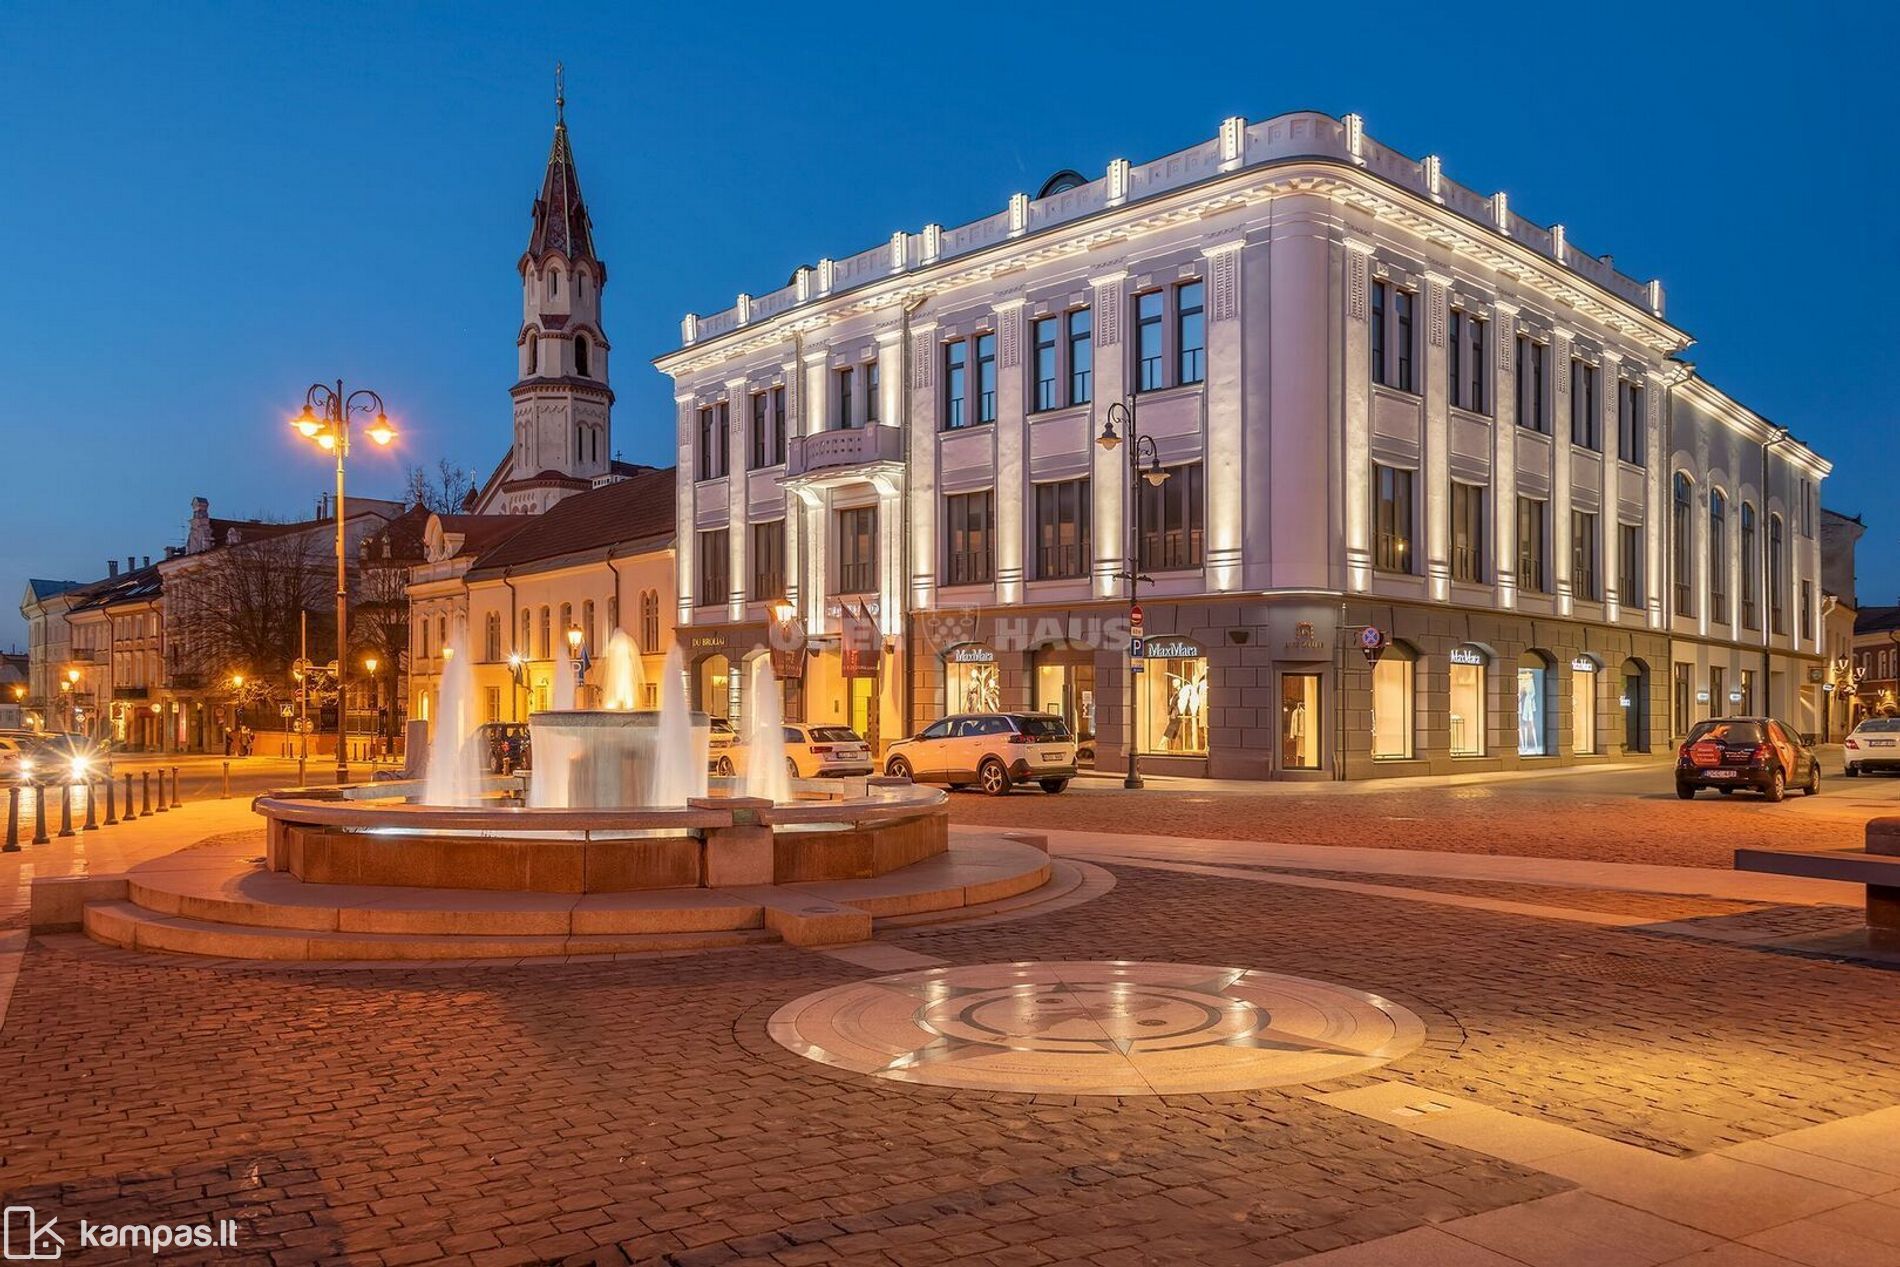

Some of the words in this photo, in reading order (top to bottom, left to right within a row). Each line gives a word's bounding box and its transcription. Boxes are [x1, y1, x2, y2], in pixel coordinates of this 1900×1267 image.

[955, 648, 994, 662] MaxMara
[1133, 639, 1142, 656] P
[1148, 642, 1198, 657] MaxMara
